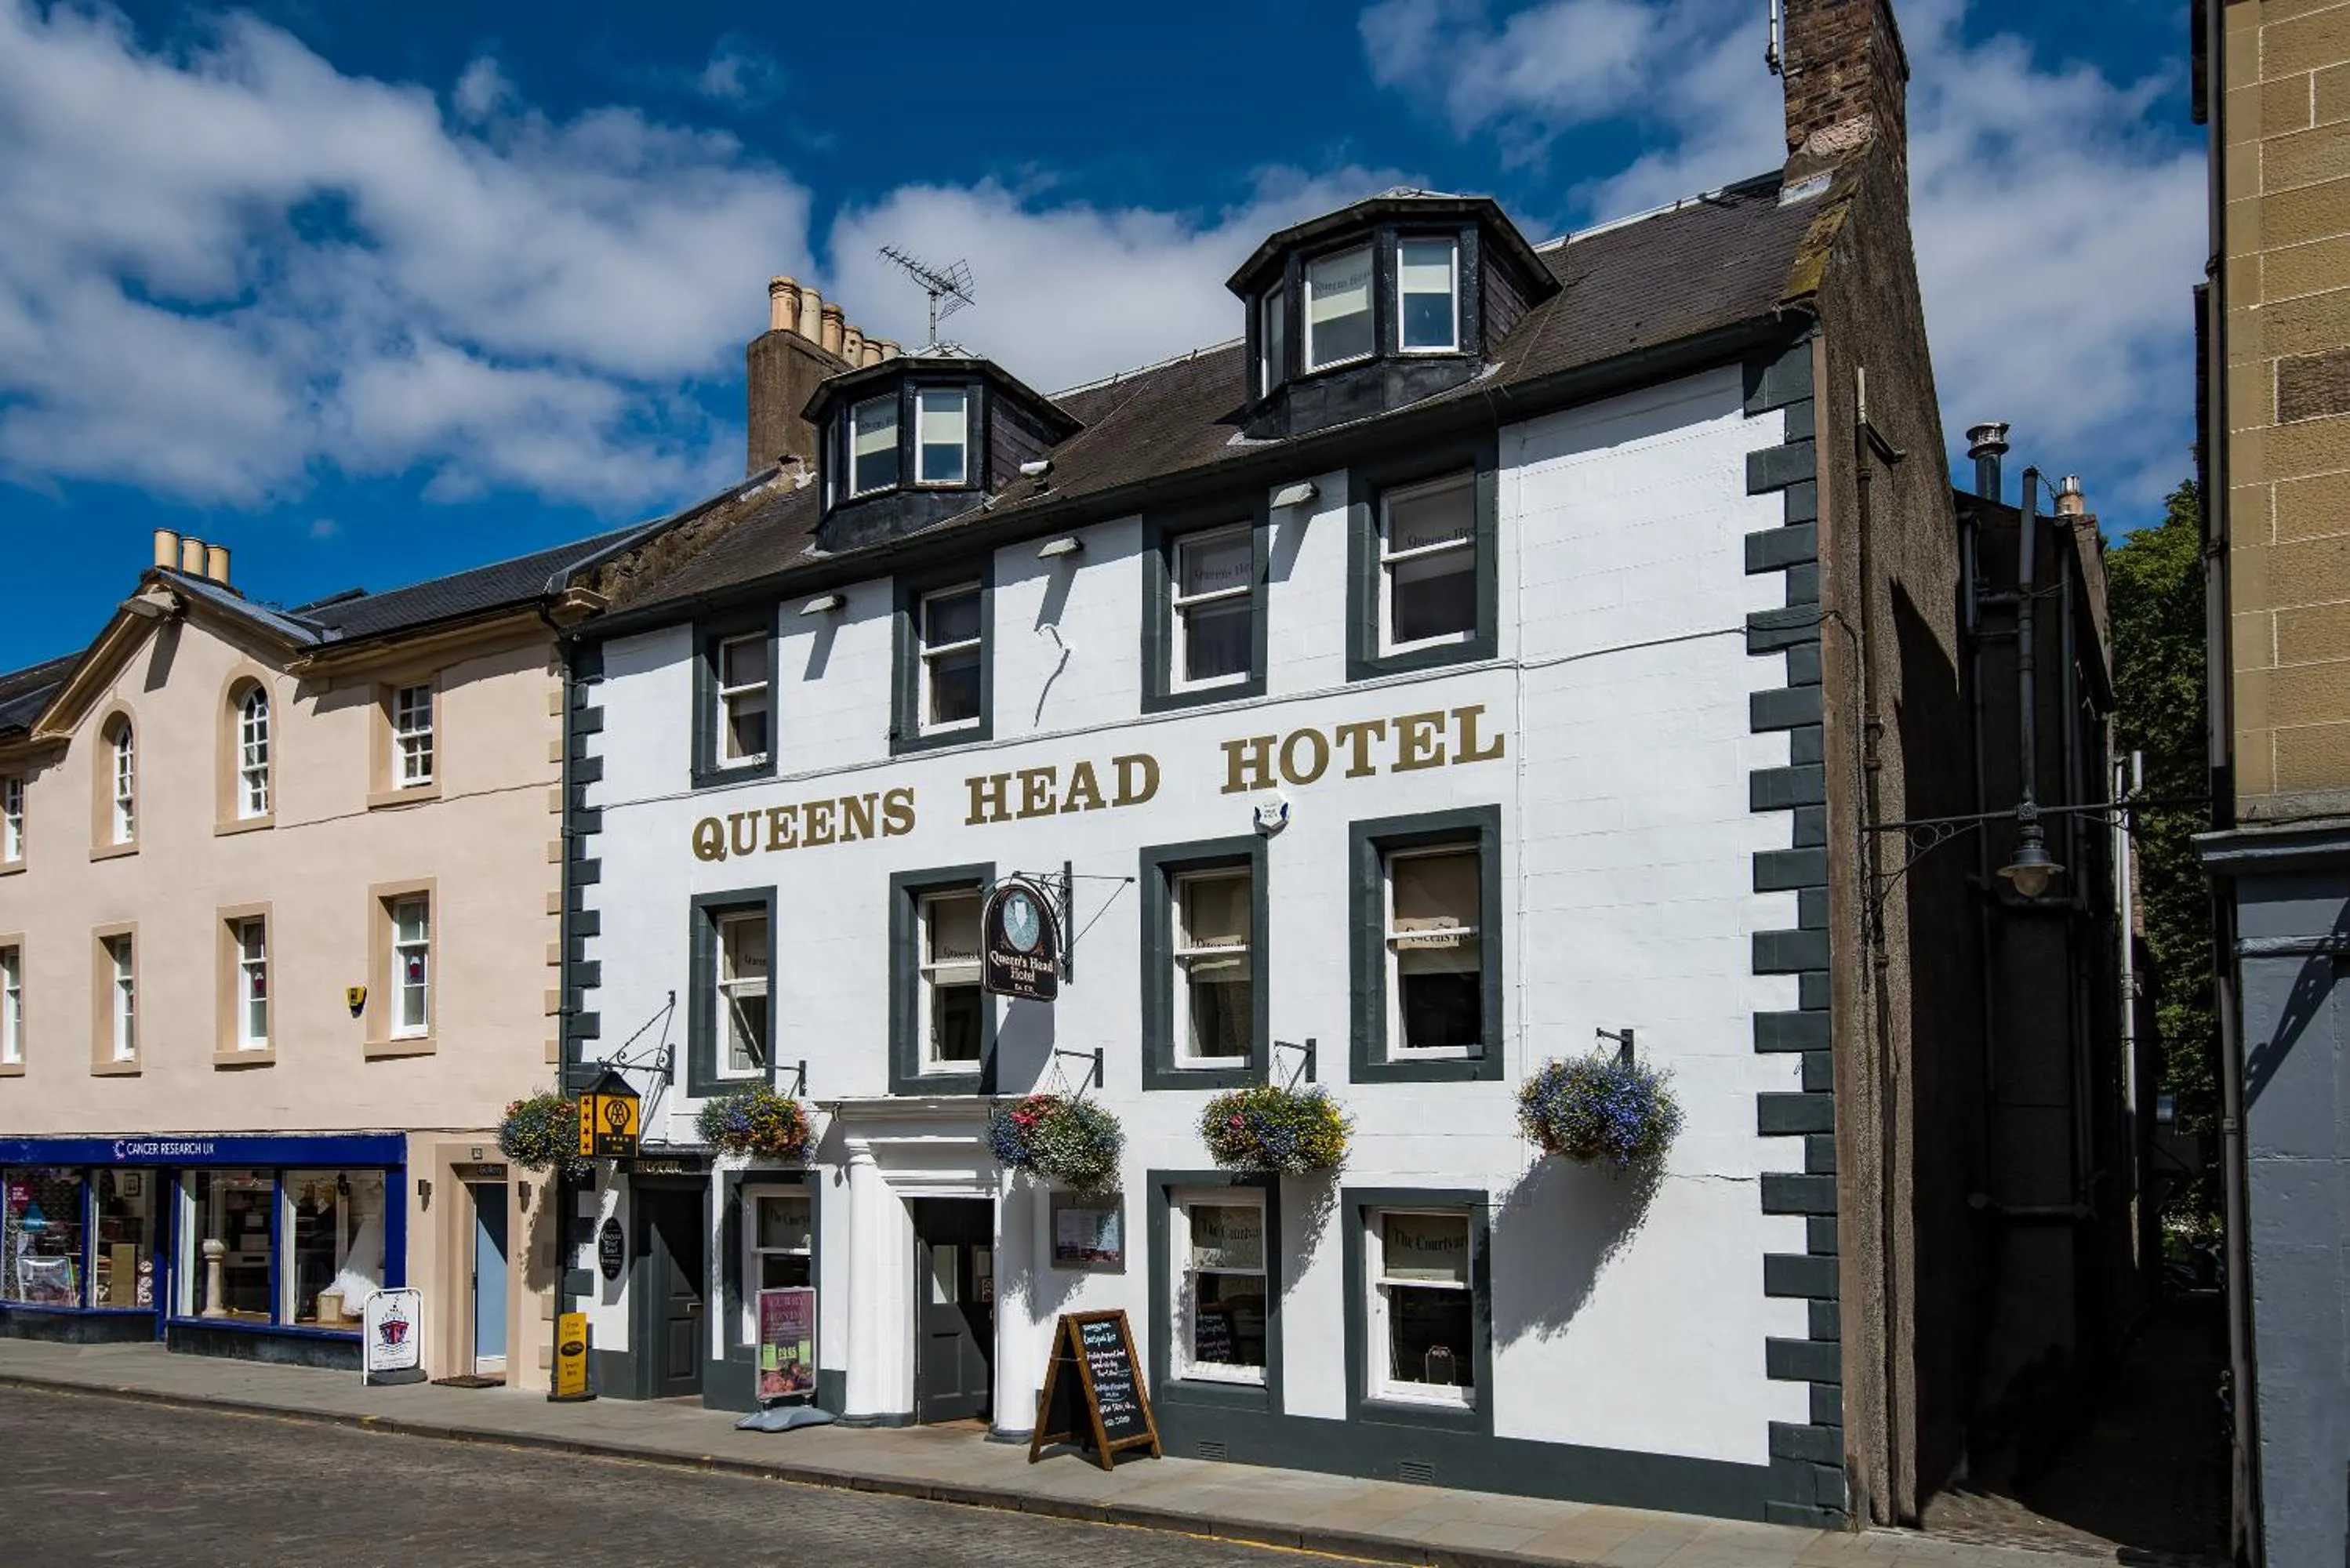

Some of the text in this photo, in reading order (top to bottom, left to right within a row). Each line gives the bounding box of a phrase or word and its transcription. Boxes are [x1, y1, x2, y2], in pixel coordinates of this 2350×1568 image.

[692, 704, 1505, 862] QUEENS HEAD HOTEL
[990, 950, 1027, 967] Queen's
[1030, 956, 1054, 972] Head
[1010, 967, 1036, 982] Hotel
[126, 1142, 214, 1156] CANCER RESEARCH UK
[1392, 1228, 1412, 1248] The
